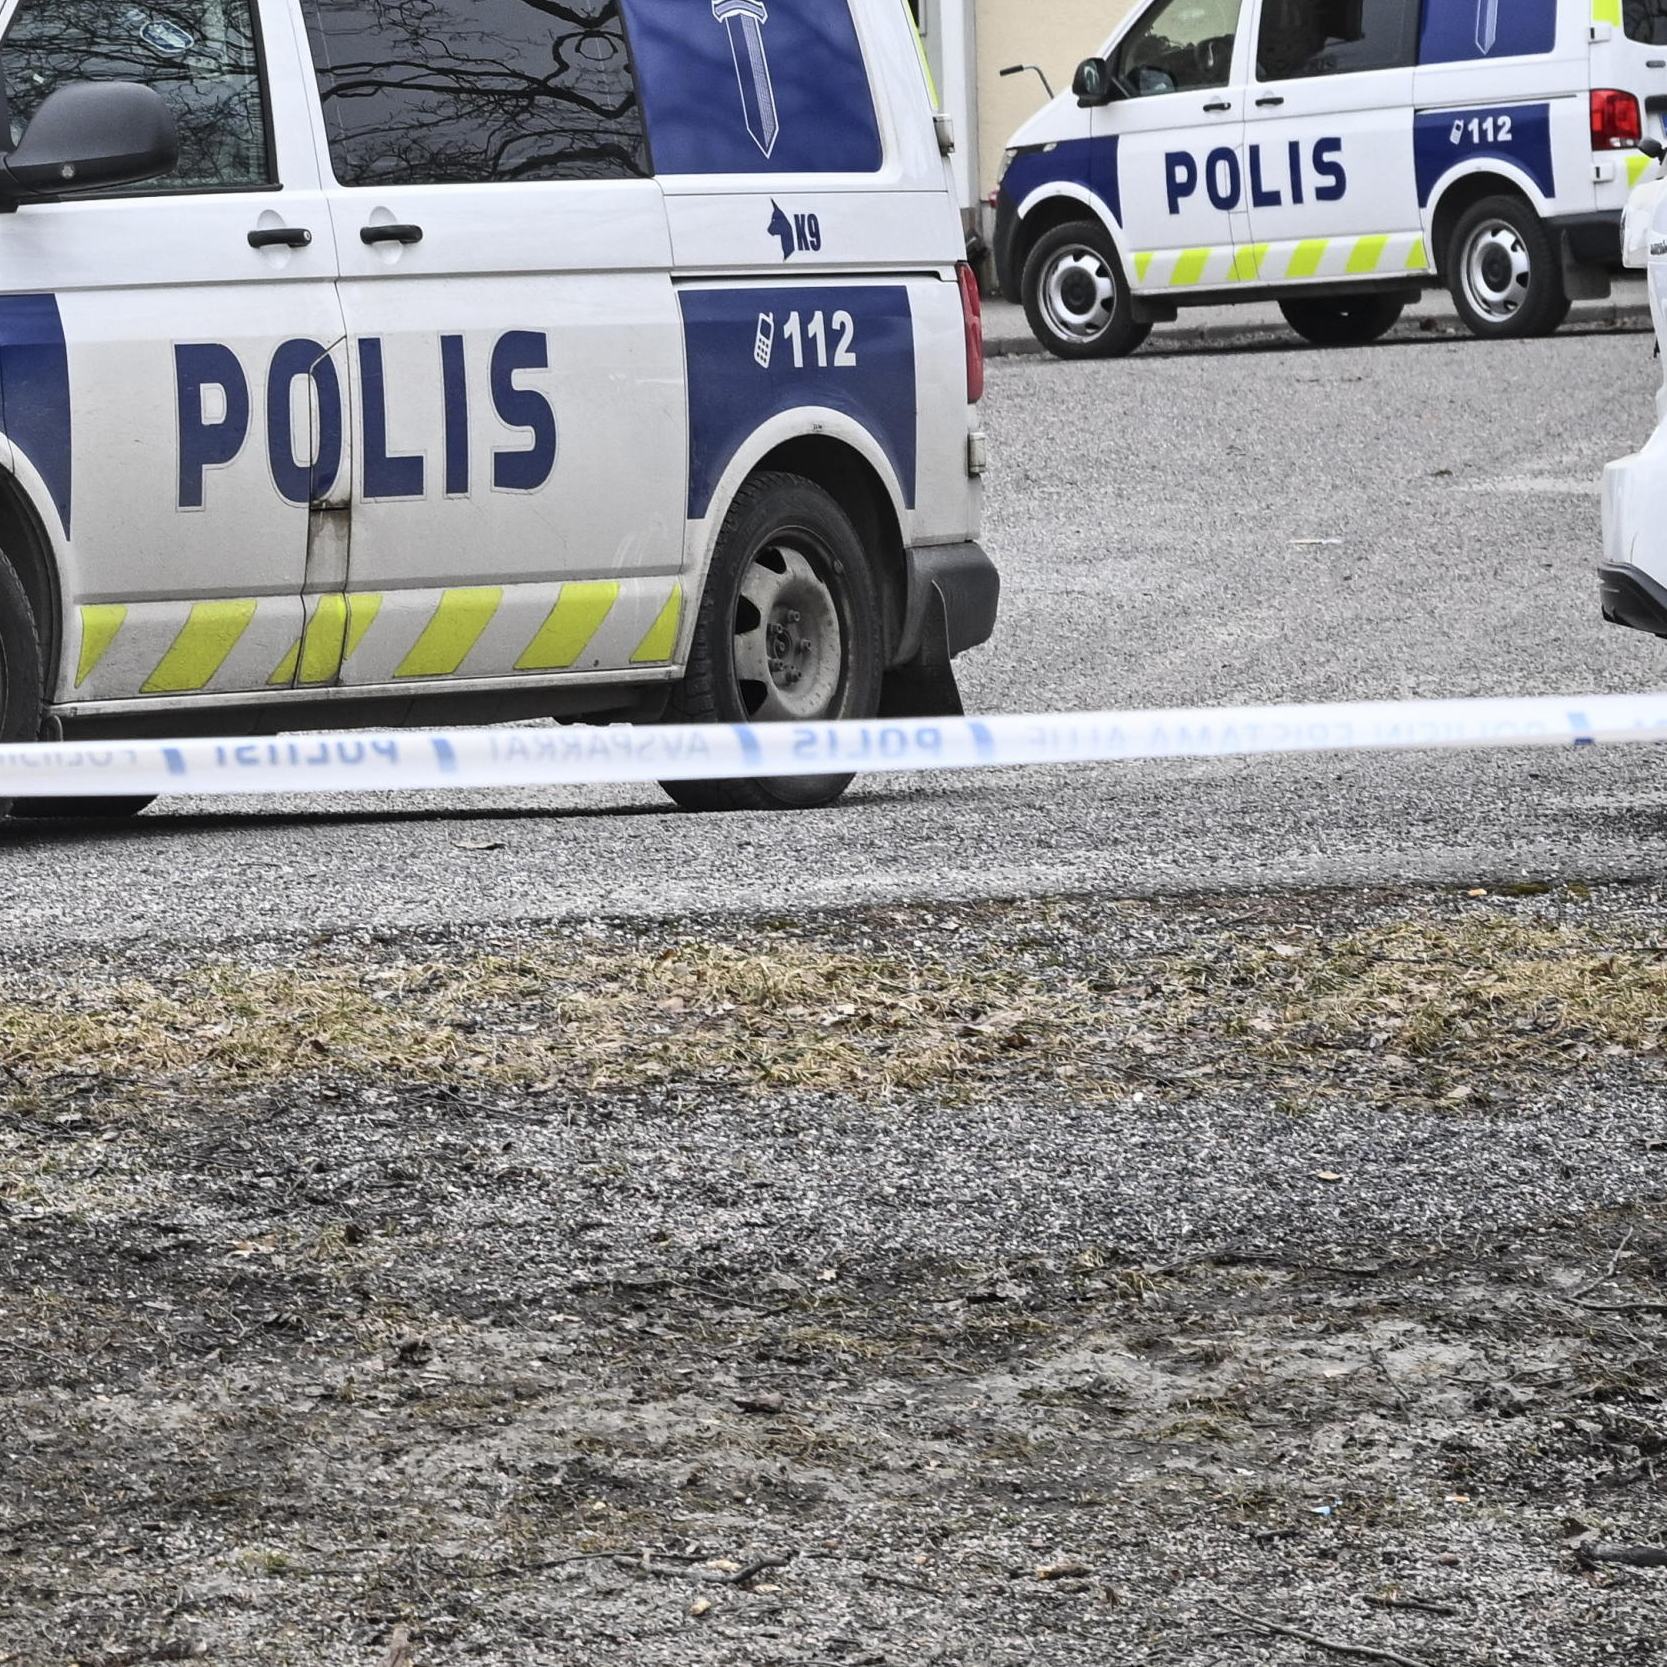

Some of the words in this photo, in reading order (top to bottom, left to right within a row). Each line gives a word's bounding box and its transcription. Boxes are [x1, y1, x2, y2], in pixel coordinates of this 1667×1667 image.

[1466, 115, 1513, 145] 112
[1164, 137, 1348, 215] POLIS
[793, 213, 822, 252] K9
[783, 310, 857, 369] 112
[174, 330, 558, 511] POLIS
